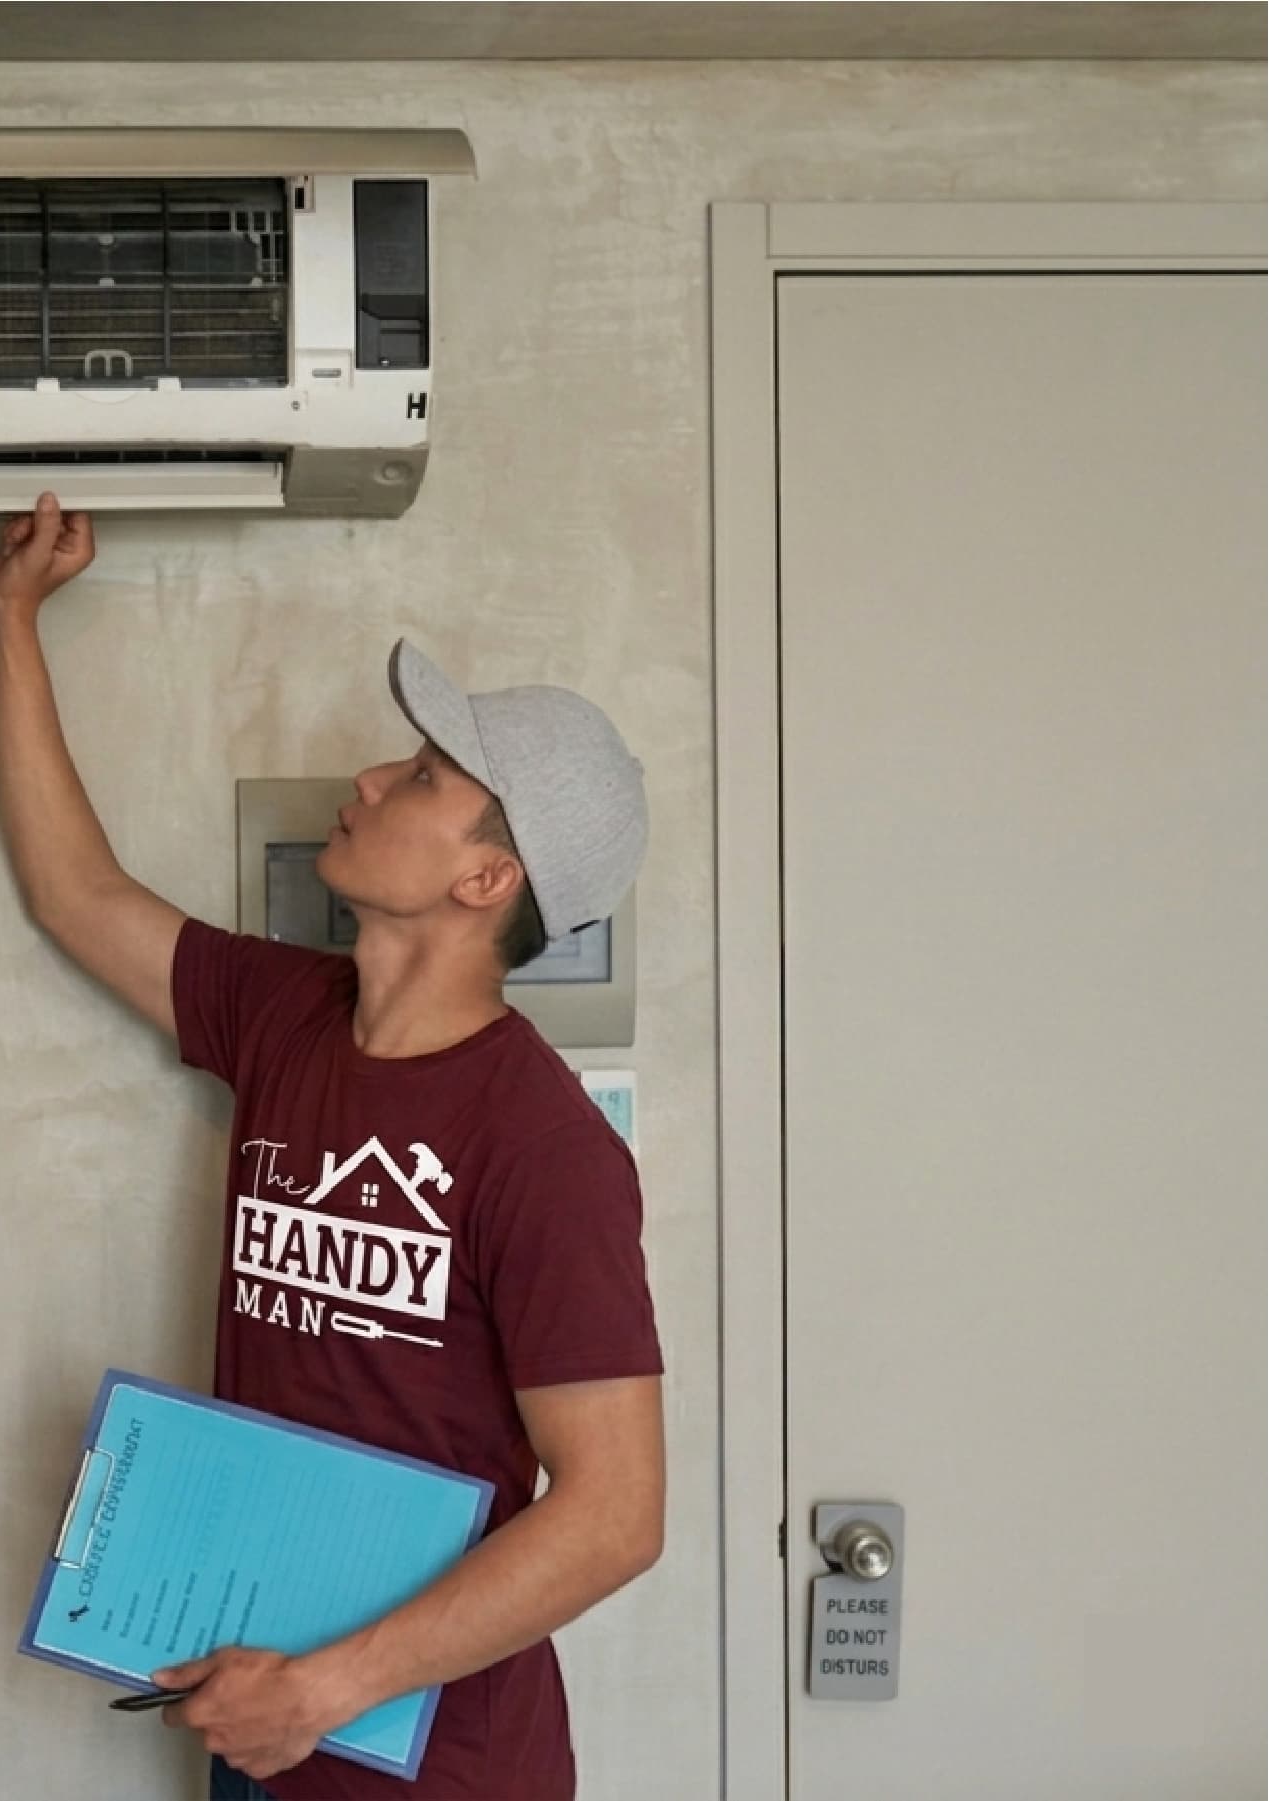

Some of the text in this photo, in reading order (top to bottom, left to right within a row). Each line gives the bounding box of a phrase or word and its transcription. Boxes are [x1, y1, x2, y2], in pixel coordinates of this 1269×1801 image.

[241, 1138, 310, 1199] The
[238, 1207, 442, 1306] HANDY
[234, 1278, 326, 1336] MAN
[827, 1599, 889, 1614] PLEASE
[827, 1629, 886, 1645] DO NOT
